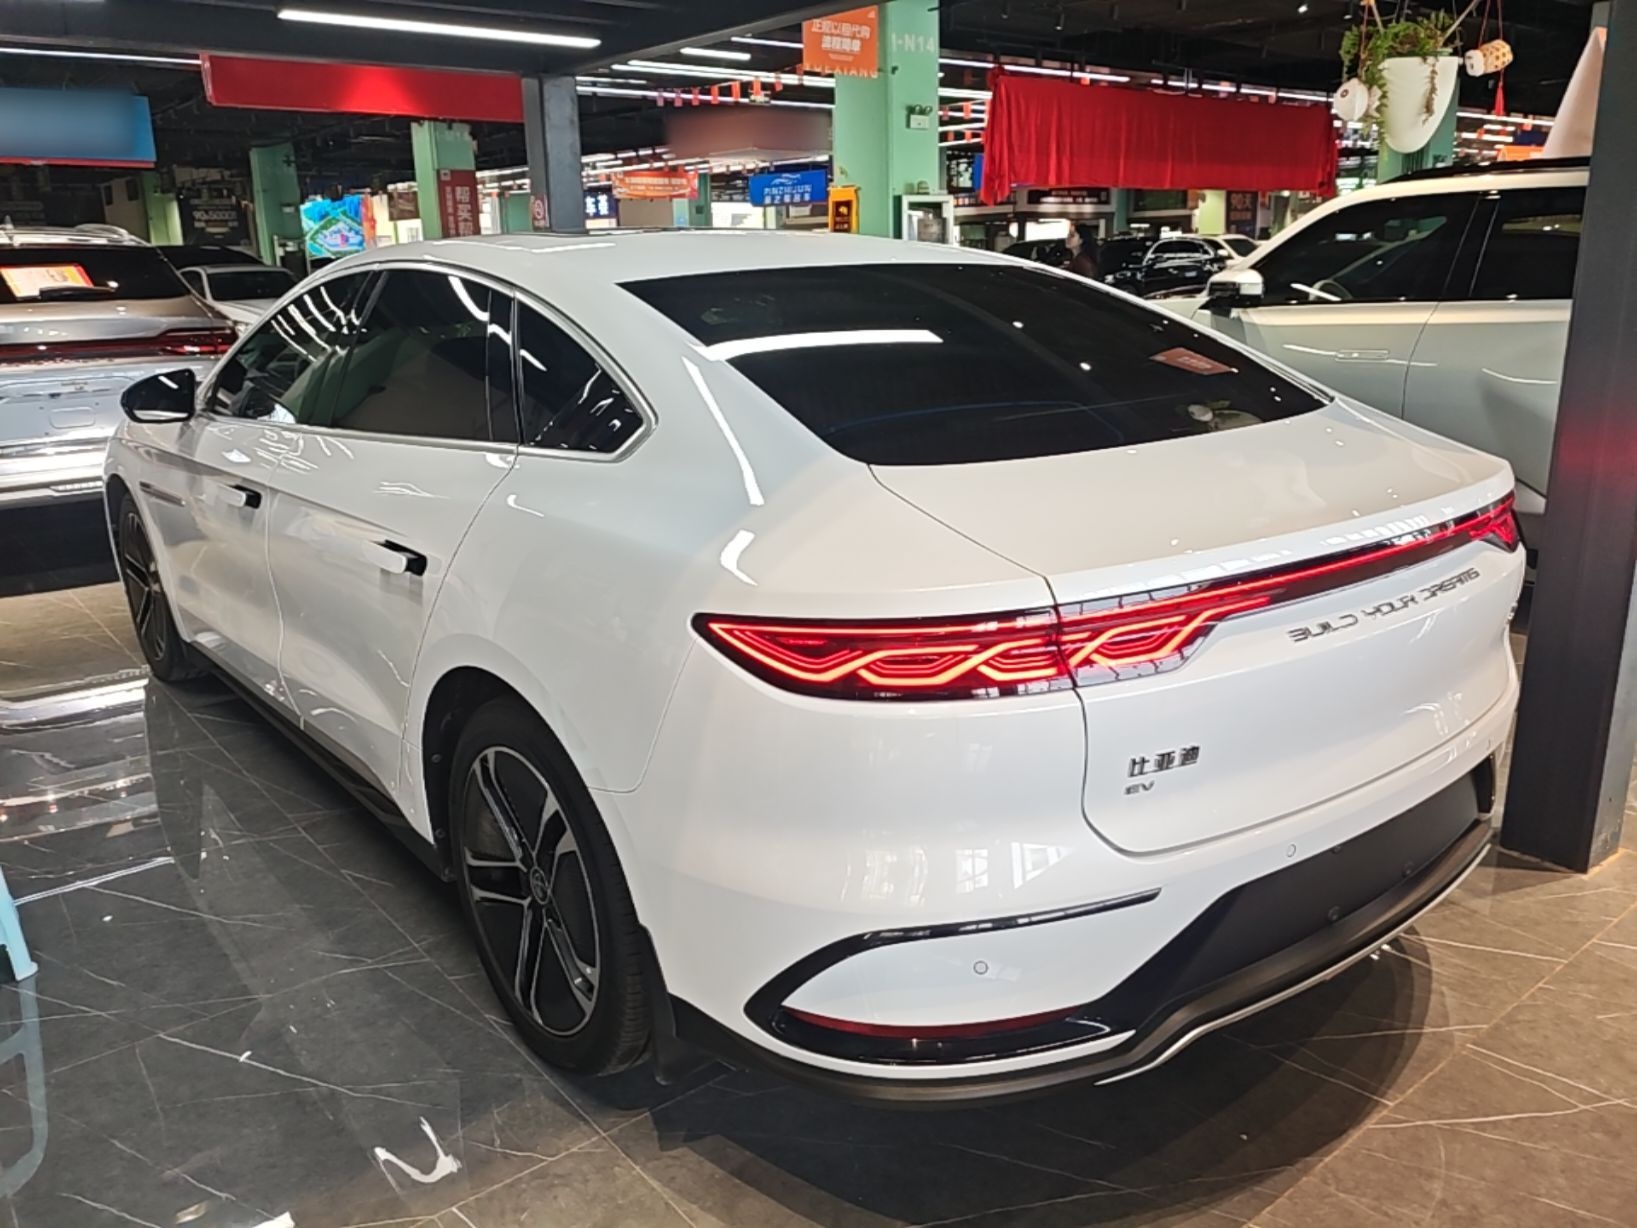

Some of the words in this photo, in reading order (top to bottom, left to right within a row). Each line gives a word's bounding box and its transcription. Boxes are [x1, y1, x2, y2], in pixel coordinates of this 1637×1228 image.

[1287, 613, 1359, 643] BUILD
[1361, 594, 1419, 621] YOUR
[1419, 567, 1481, 601] DREAMS
[1127, 745, 1200, 778] 比亚迪
[1124, 779, 1155, 795] EV
